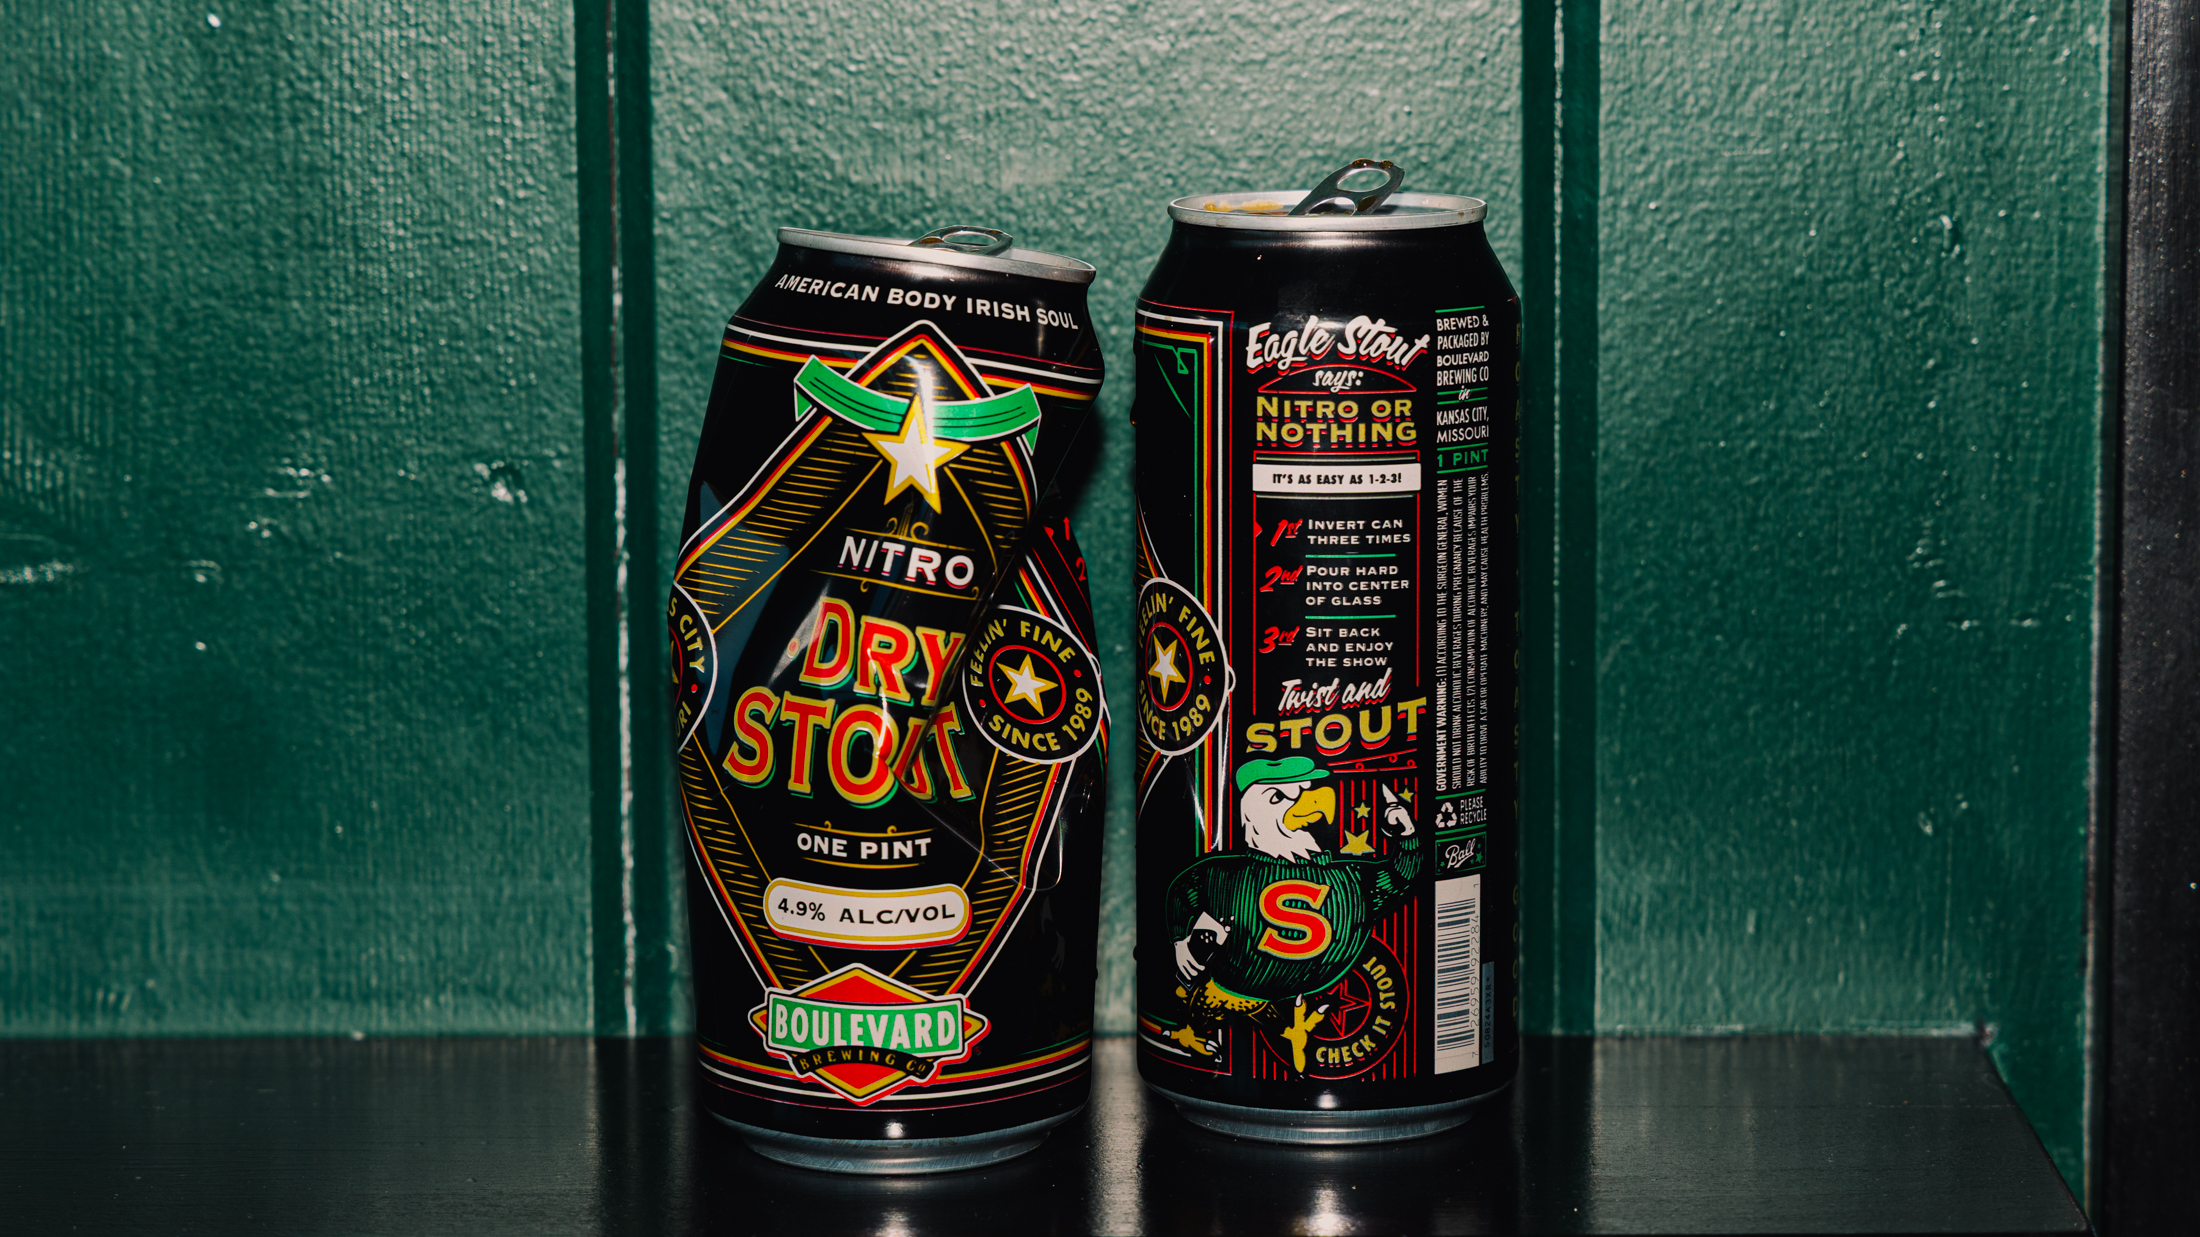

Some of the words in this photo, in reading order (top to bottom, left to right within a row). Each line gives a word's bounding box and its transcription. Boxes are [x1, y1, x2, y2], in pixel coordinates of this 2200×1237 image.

[775, 273, 879, 303] AMERICAN
[886, 288, 957, 312] BODY
[966, 297, 1031, 323] IRISH
[1035, 307, 1079, 331] SOUL
[1436, 315, 1479, 331] BREWED
[1481, 314, 1490, 327] &
[1246, 316, 1336, 373] Eagle
[1337, 315, 1430, 370] Stout
[1436, 333, 1478, 351] PACKAGED
[1479, 331, 1490, 347] BY
[1436, 350, 1490, 367] BOULEVARD
[1312, 367, 1364, 393] says:
[1436, 367, 1478, 387] BREWING
[1478, 365, 1490, 382] CO
[1457, 385, 1472, 401] in
[1256, 396, 1359, 423] NITRO
[1369, 398, 1413, 423] OR
[1436, 408, 1470, 427] KANSAS
[1471, 406, 1490, 423] CITY,
[1256, 421, 1418, 448] NOTHING
[1436, 424, 1490, 444] MISSOURI
[1436, 454, 1445, 468] 1
[1453, 448, 1489, 467] PINT
[1272, 473, 1294, 485] IT'S
[1298, 473, 1313, 485] AS
[1316, 473, 1345, 485] EASY
[1349, 473, 1364, 485] AS
[1368, 471, 1403, 485] 1-2-3!
[1453, 478, 1463, 493] THE
[1467, 476, 1477, 497] YOUR
[1437, 479, 1448, 512] WOMEN
[1453, 496, 1463, 506] OF
[1307, 519, 1366, 532] INVERT
[1370, 517, 1404, 530] CAN
[1453, 508, 1463, 542] BECAUSE
[1467, 498, 1477, 530] IMPAIRS
[1270, 518, 1303, 547] 1st
[1307, 533, 1361, 545] THREE
[1365, 532, 1412, 545] TIMES
[1480, 516, 1489, 544] HEALTH
[837, 534, 976, 590] NITRO
[1306, 565, 1353, 578] POUR
[1355, 564, 1400, 577] HARD
[1436, 552, 1447, 590] SURGEON
[1452, 544, 1462, 590] PREGNANCY
[1480, 548, 1489, 570] CAUSE
[1259, 565, 1303, 593] 2nd
[1306, 579, 1345, 592] INTO
[1348, 578, 1410, 591] CENTER
[1480, 572, 1489, 588] MAY
[1306, 595, 1328, 606] OF
[1331, 594, 1383, 606] GLASS
[1436, 591, 1447, 606] THE
[1452, 592, 1462, 622] DURING
[1480, 588, 1489, 604] AND
[1436, 607, 1447, 618] TO
[1466, 619, 1476, 628] OF
[679, 613, 706, 674] CITY
[1178, 605, 1216, 666] FINE
[1258, 625, 1300, 653] 3rd
[1305, 626, 1335, 639] SIT
[1338, 626, 1381, 638] BACK
[1436, 620, 1447, 664] ACCORDING
[798, 596, 967, 708] DRY
[970, 618, 1008, 688] FEELIN'
[1019, 618, 1076, 665] FINE
[1305, 640, 1339, 653] AND
[1343, 640, 1394, 653] ENJOY
[1452, 624, 1462, 668] BEVERAGES
[1466, 629, 1476, 684] CONSUMPTION
[1305, 656, 1337, 668] THE
[1340, 655, 1389, 668] SHOW
[1435, 665, 1447, 677] (1)
[1479, 654, 1488, 686] OPERATE
[1278, 678, 1341, 714] Twist
[1340, 667, 1394, 709] and
[1436, 678, 1447, 728] WARNING:
[1452, 671, 1462, 712] ALCOHOLIC
[1479, 686, 1488, 698] OR
[988, 712, 1062, 752] SINCE
[1062, 686, 1093, 743] 1989
[1138, 679, 1168, 742] SINCE
[1172, 693, 1211, 742] 1989
[1479, 700, 1488, 714] CAR
[1245, 696, 1428, 756] STOUT
[1452, 713, 1462, 739] DRINK
[1479, 724, 1488, 745] DRIVE
[1452, 741, 1462, 756] NOT
[1466, 732, 1476, 756] BIRTH
[1479, 746, 1488, 756] TO
[1436, 730, 1447, 791] GOVERNMENT
[1466, 758, 1476, 767] OF
[1479, 757, 1488, 784] ABILITY
[1452, 758, 1462, 790] SHOULD
[1466, 768, 1476, 786] RISK
[1459, 796, 1484, 812] PLEASE
[1459, 808, 1488, 825] RECYCLE
[796, 831, 848, 859] ONE
[859, 836, 932, 861] PINT
[1445, 839, 1477, 869] Ball
[777, 897, 827, 922] 4.9%
[838, 903, 956, 926] ALC/VOL
[1256, 879, 1333, 961] S
[1470, 914, 1480, 967] 92284
[1362, 956, 1399, 1012] STOUT
[1470, 976, 1480, 1028] 26959
[773, 1002, 957, 1050] BOULEVARD
[1373, 1014, 1394, 1038] IT
[799, 1047, 897, 1073] BREWING
[1315, 1034, 1377, 1067] CHECK
